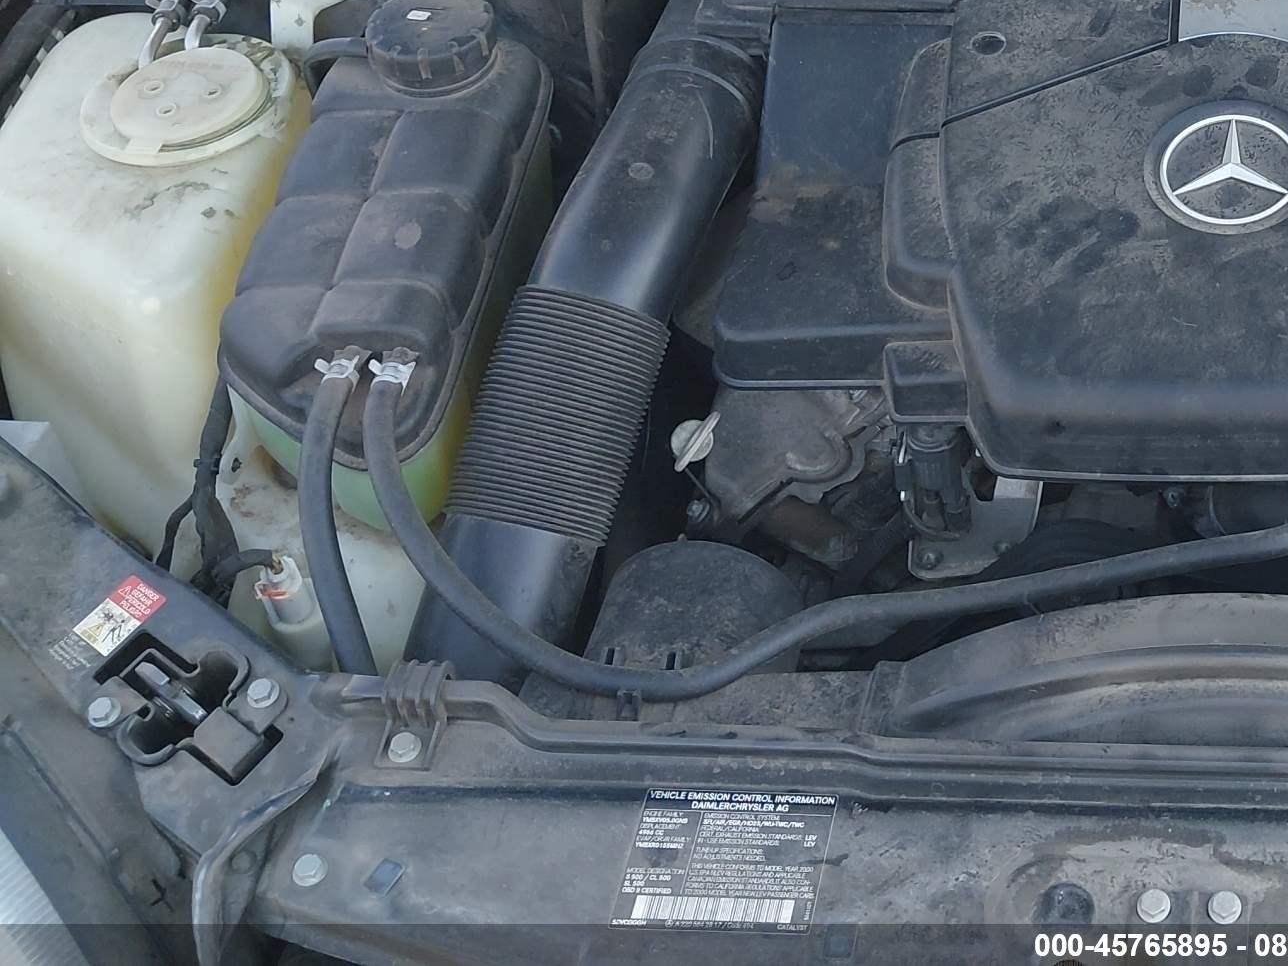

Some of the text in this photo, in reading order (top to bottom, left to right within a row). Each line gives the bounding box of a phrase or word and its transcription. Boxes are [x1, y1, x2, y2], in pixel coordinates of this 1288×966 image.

[137, 583, 160, 602] DANGER
[650, 790, 835, 804] VEHICLE EMISSION CONTROL INFORMATION
[691, 801, 774, 811] DAIMLERCHRYSLER
